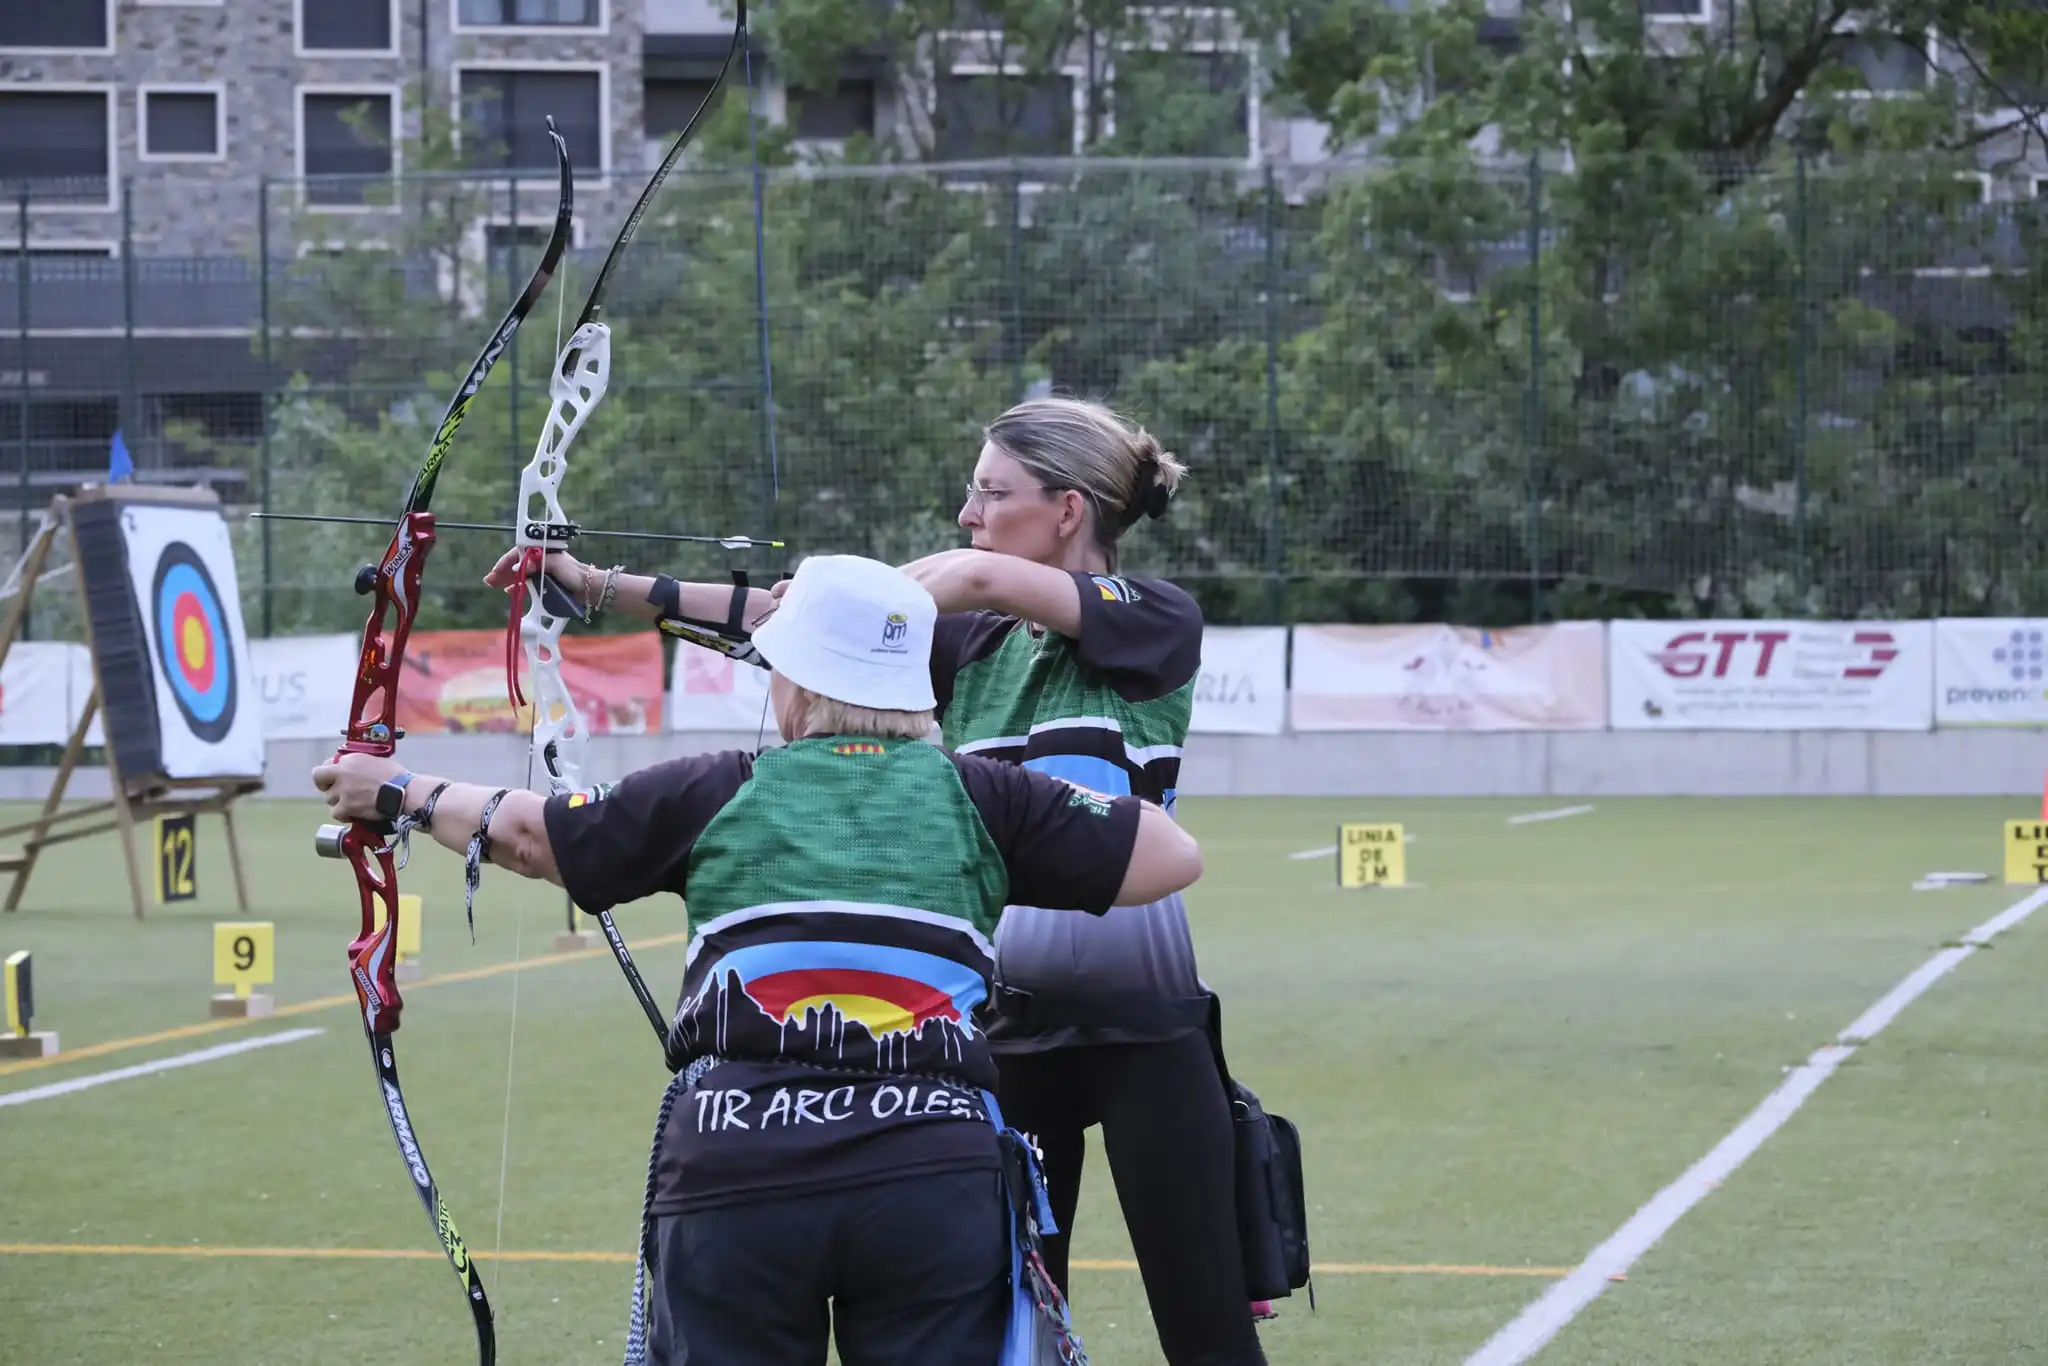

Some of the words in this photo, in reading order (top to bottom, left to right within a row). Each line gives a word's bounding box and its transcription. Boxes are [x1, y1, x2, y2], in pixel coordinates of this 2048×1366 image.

[1660, 631, 1791, 679] GTT
[163, 825, 193, 895] 12
[232, 935, 256, 971] 9
[382, 1076, 430, 1188] ARMATO
[694, 1087, 750, 1133] TIR
[760, 1085, 855, 1131] ARC
